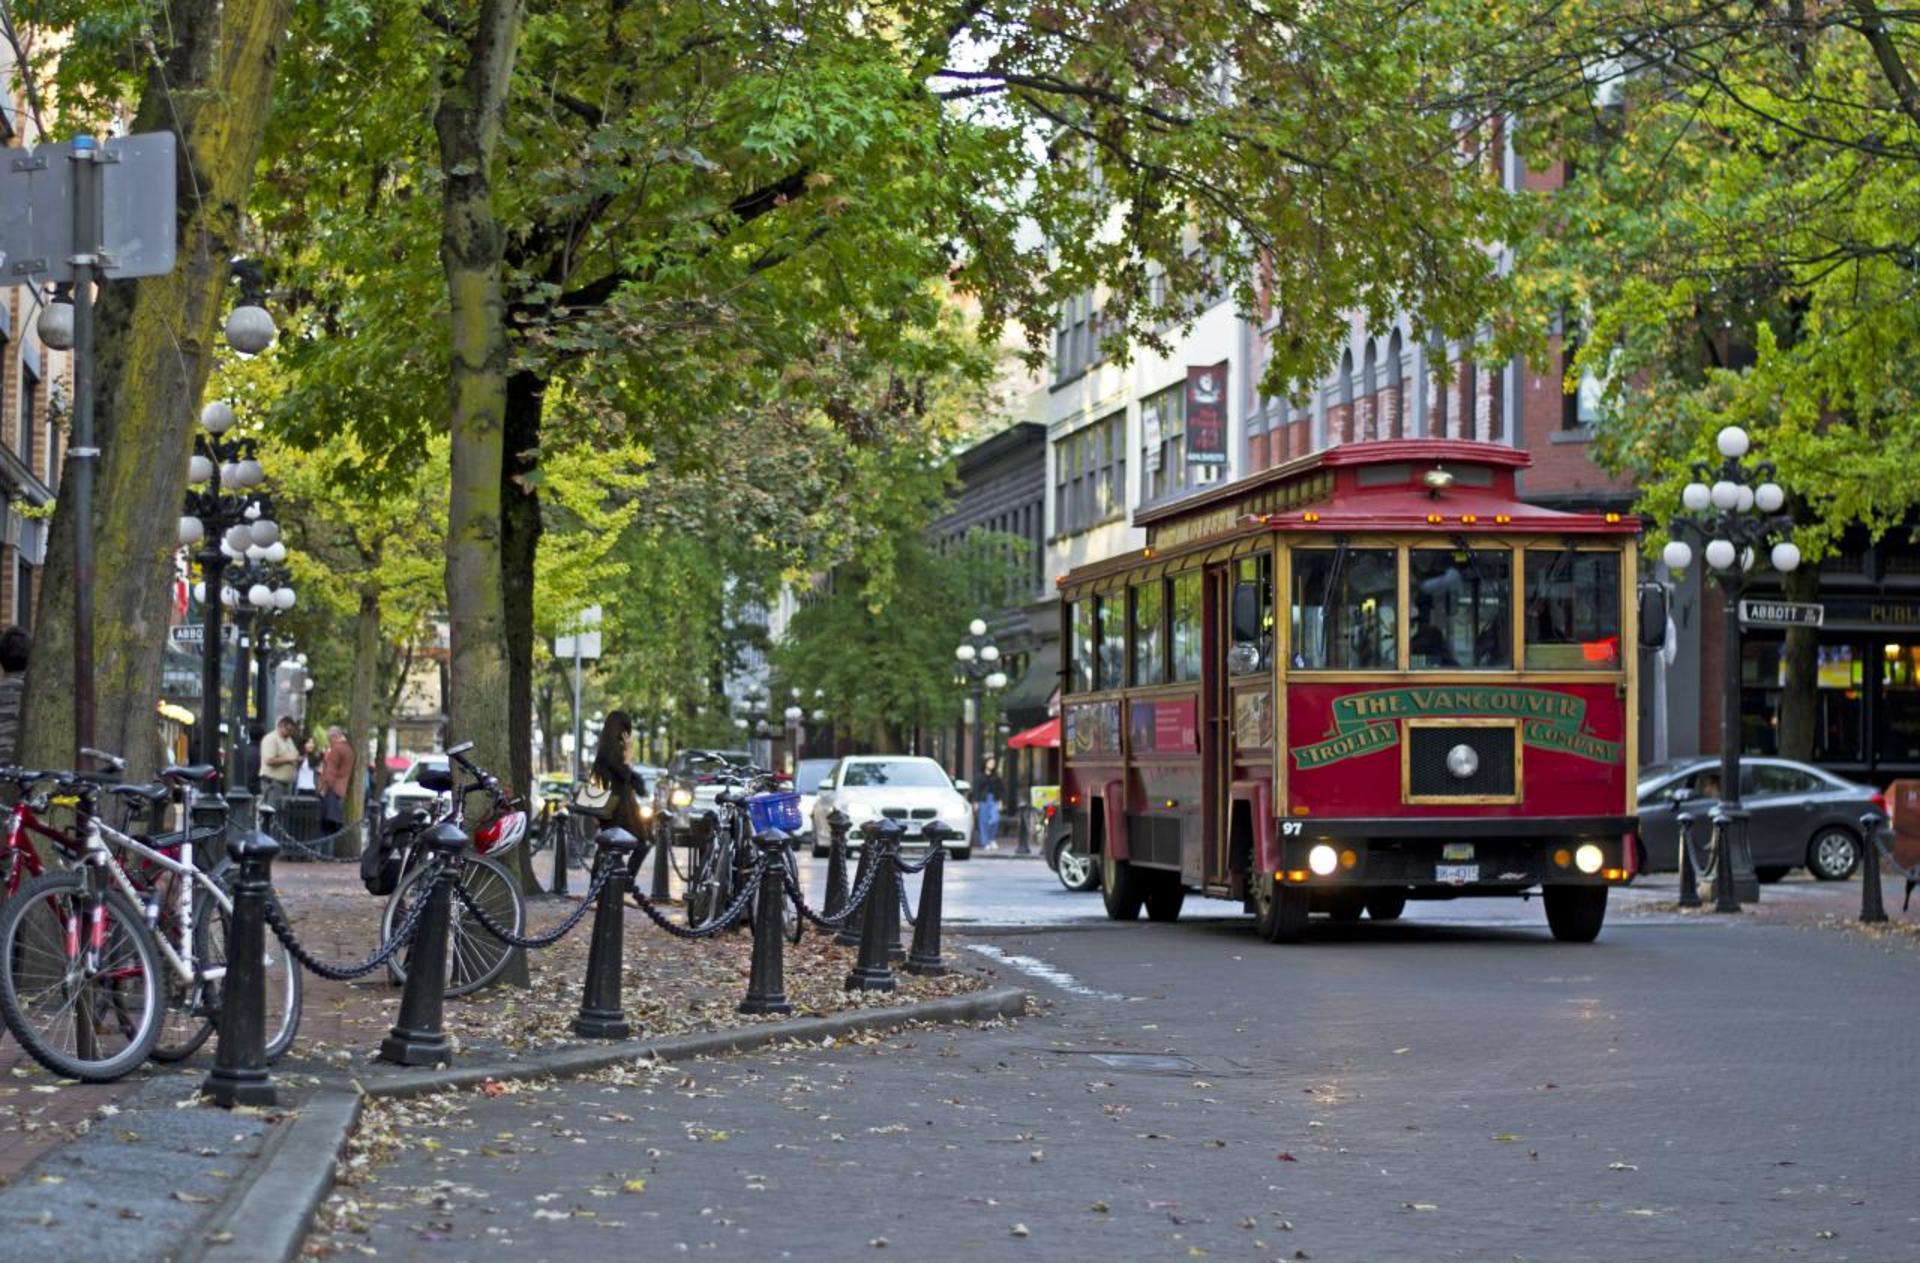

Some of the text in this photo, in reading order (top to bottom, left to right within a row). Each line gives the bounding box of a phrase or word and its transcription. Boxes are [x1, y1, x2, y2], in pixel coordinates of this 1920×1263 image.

[1751, 605, 1797, 620] ABBOTT
[1343, 688, 1577, 717] THE VANCOUVER
[1302, 720, 1616, 763] TROLLEY COMPANY
[1282, 821, 1303, 836] 97
